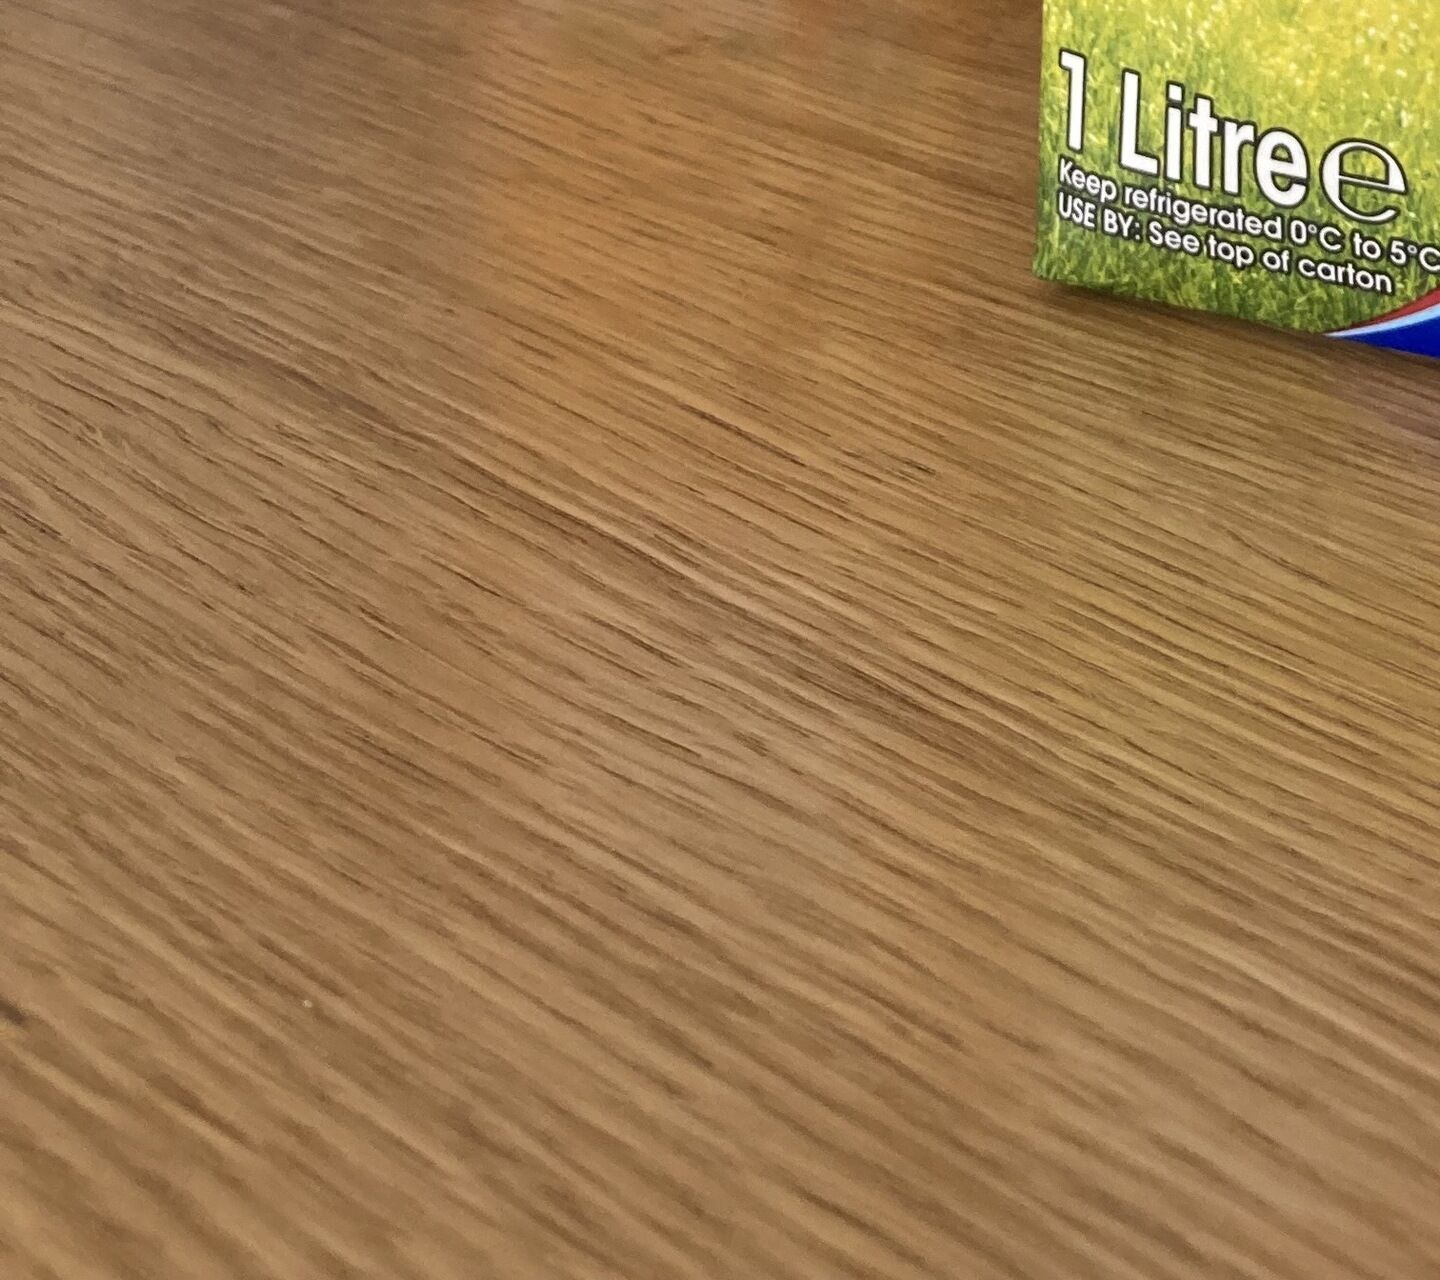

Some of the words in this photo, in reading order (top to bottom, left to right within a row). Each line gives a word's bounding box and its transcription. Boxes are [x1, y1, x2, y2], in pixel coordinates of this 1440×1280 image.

[1057, 47, 1088, 154] 1
[1117, 67, 1311, 209] Litre
[1057, 156, 1118, 203] Keep
[1123, 184, 1284, 241] refrigerated
[1289, 219, 1344, 253] 0°C
[1352, 231, 1383, 261] to
[1057, 190, 1098, 230] USE
[1103, 206, 1143, 243] BY:
[1148, 221, 1202, 256] See
[1206, 233, 1256, 272] top
[1261, 246, 1292, 276] of
[1298, 256, 1395, 297] carton
